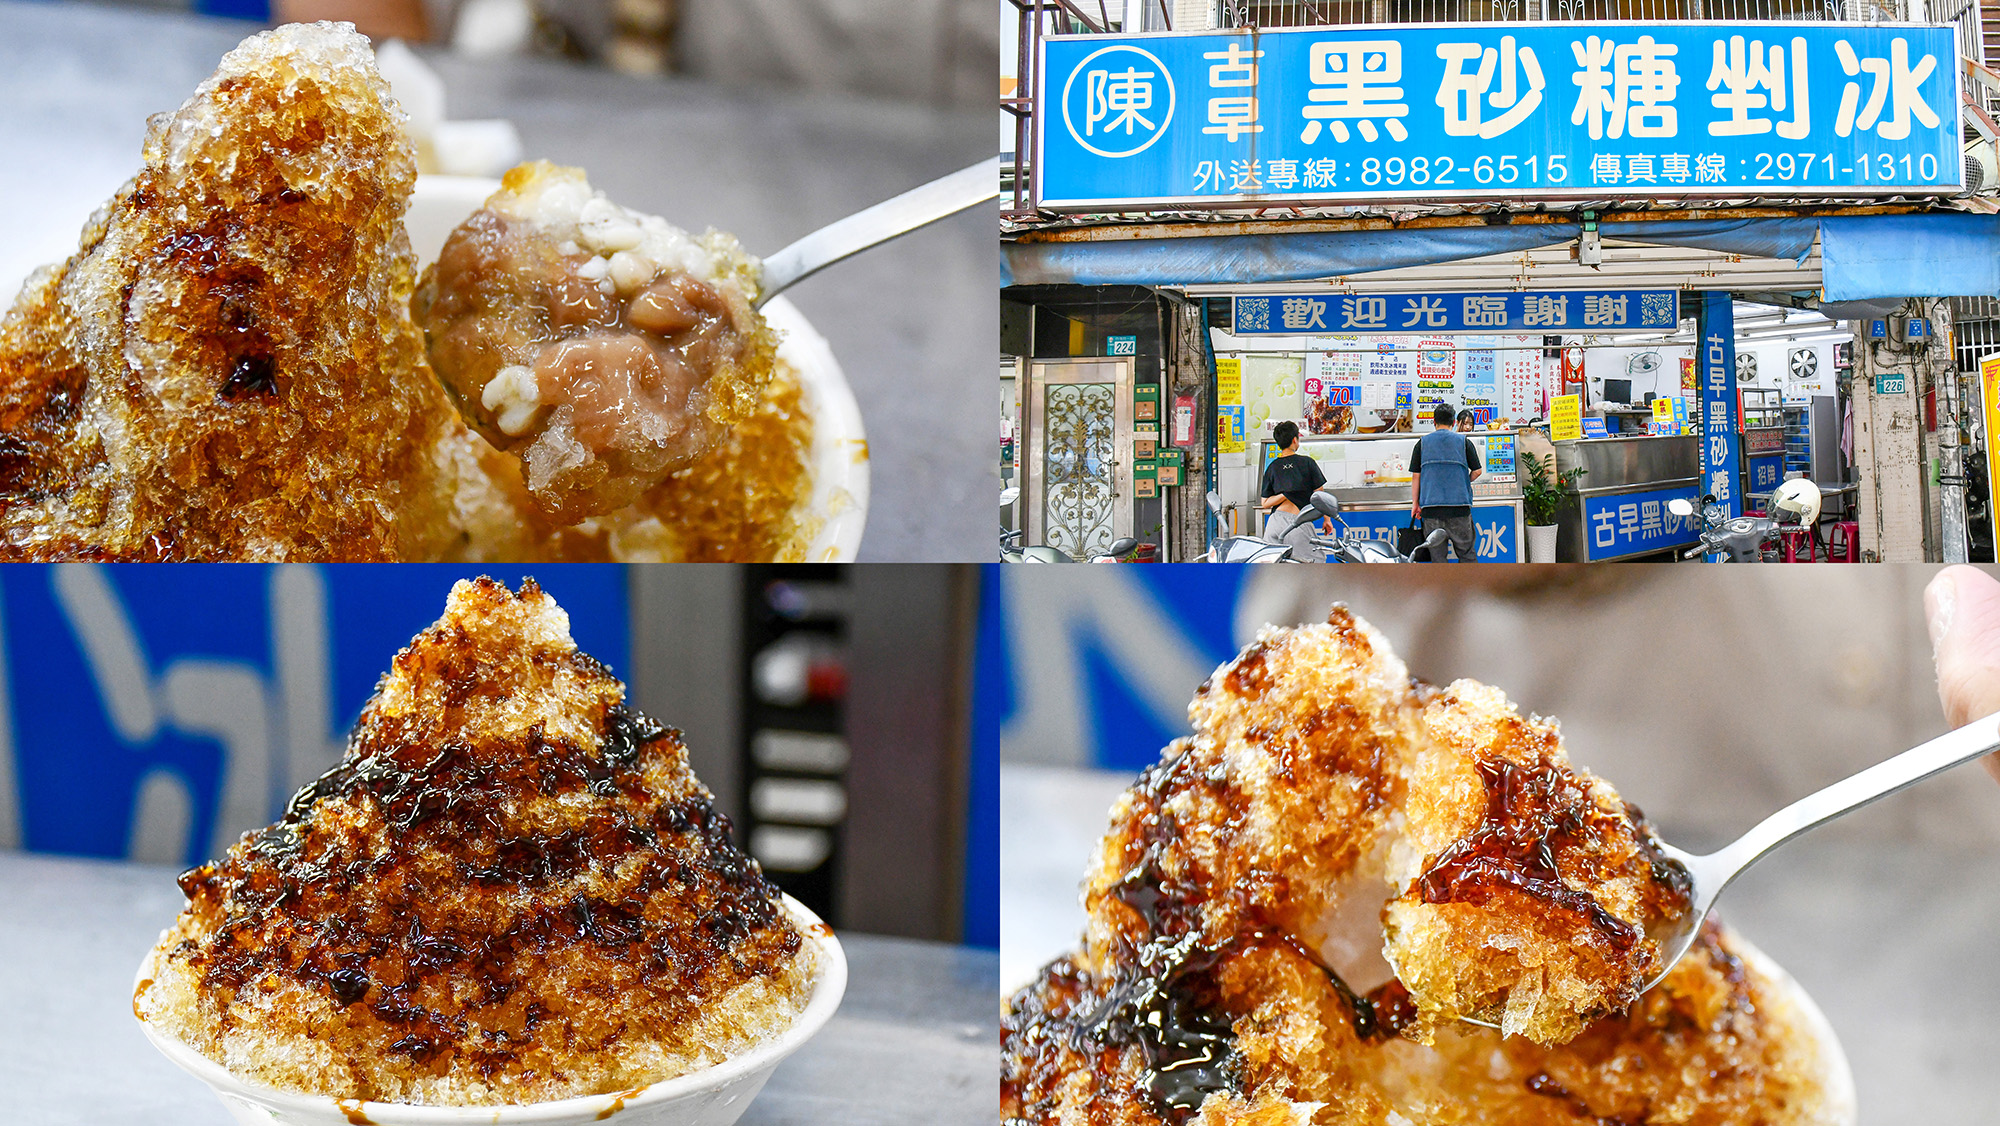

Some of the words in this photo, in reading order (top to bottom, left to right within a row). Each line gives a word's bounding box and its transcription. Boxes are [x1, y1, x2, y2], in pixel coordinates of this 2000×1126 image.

[1086, 67, 1155, 137] 陳
[1202, 43, 1265, 143] 古早
[1281, 295, 1629, 330] 歡迎光臨謝謝
[1115, 342, 1134, 353] 224
[1307, 380, 1318, 389] 26
[1885, 380, 1903, 392] 226
[1331, 387, 1350, 405] 70
[1474, 408, 1490, 424] 70
[1757, 464, 1776, 486] 招牌
